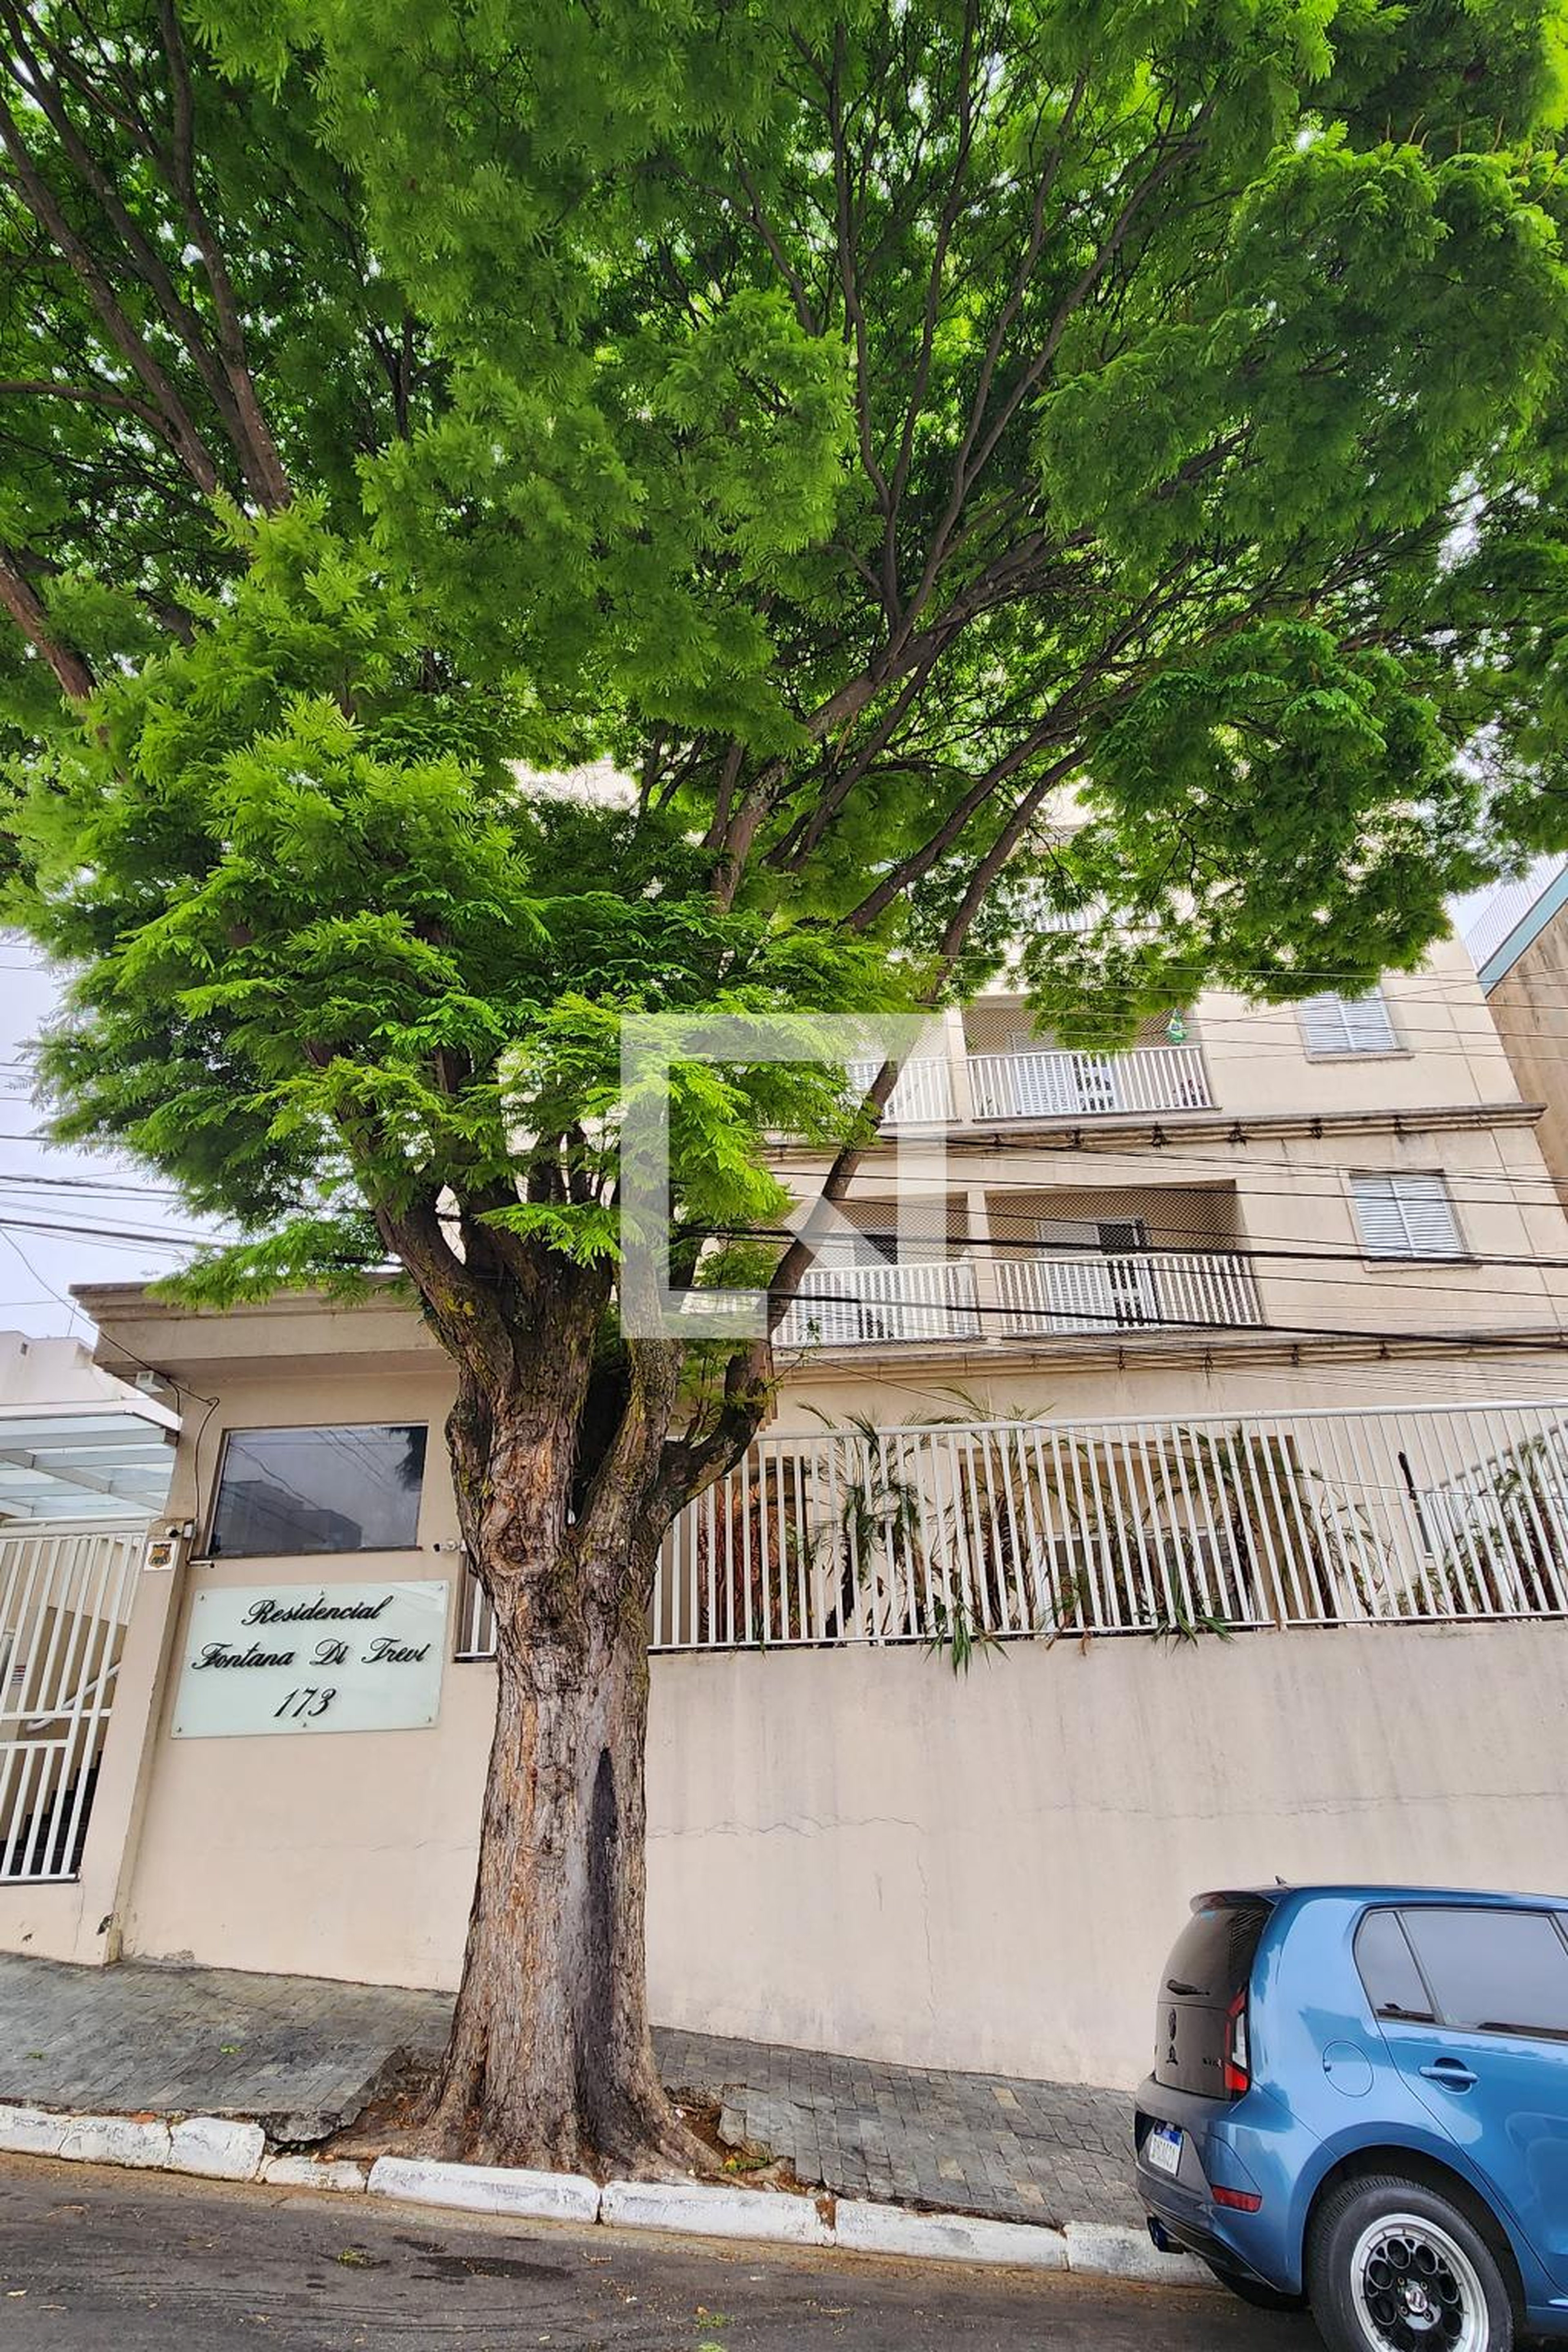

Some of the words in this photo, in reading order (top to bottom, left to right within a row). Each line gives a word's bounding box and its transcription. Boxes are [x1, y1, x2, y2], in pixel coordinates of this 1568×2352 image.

[241, 1595, 394, 1626] Residencial
[191, 1642, 296, 1670] Fontana
[309, 1638, 349, 1666] Di
[361, 1637, 431, 1664] Trevi
[274, 1688, 337, 1717] 173
